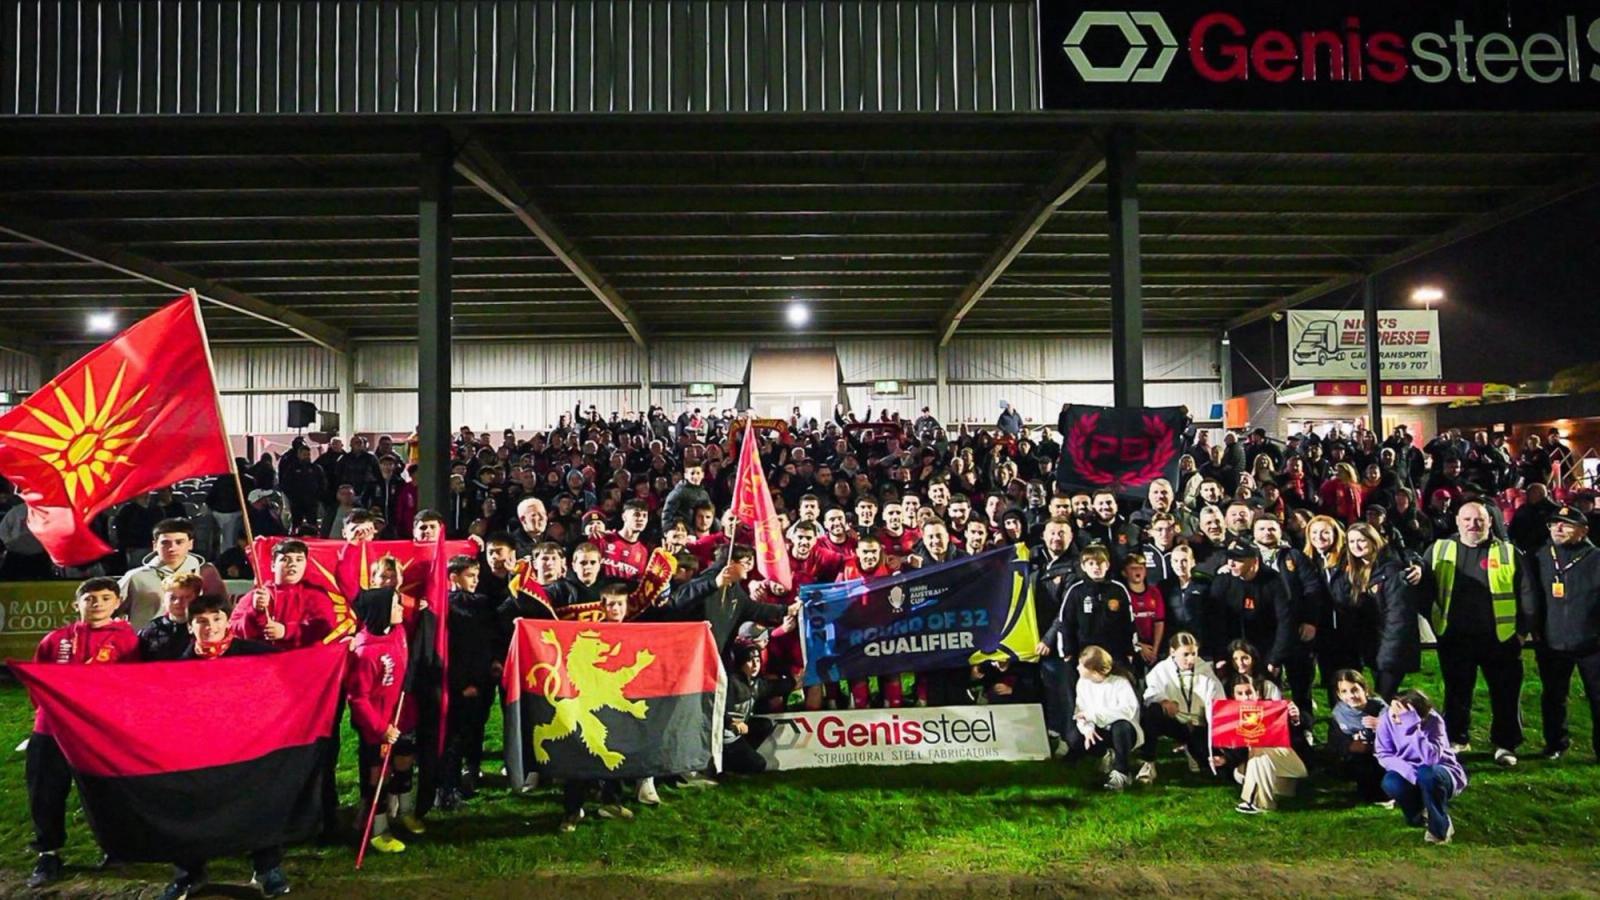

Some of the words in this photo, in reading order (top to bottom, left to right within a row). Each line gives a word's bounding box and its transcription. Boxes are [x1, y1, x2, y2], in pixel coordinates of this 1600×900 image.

[1343, 318, 1397, 328] NIK'S
[1355, 331, 1414, 345] ERESS
[1360, 362, 1385, 370] 00
[1410, 362, 1428, 370] 707
[1402, 385, 1447, 394] COFFEE
[927, 612, 956, 630] OF
[960, 608, 989, 628] 32
[863, 631, 975, 657] QUALIFIER
[816, 711, 997, 749] Genissteel
